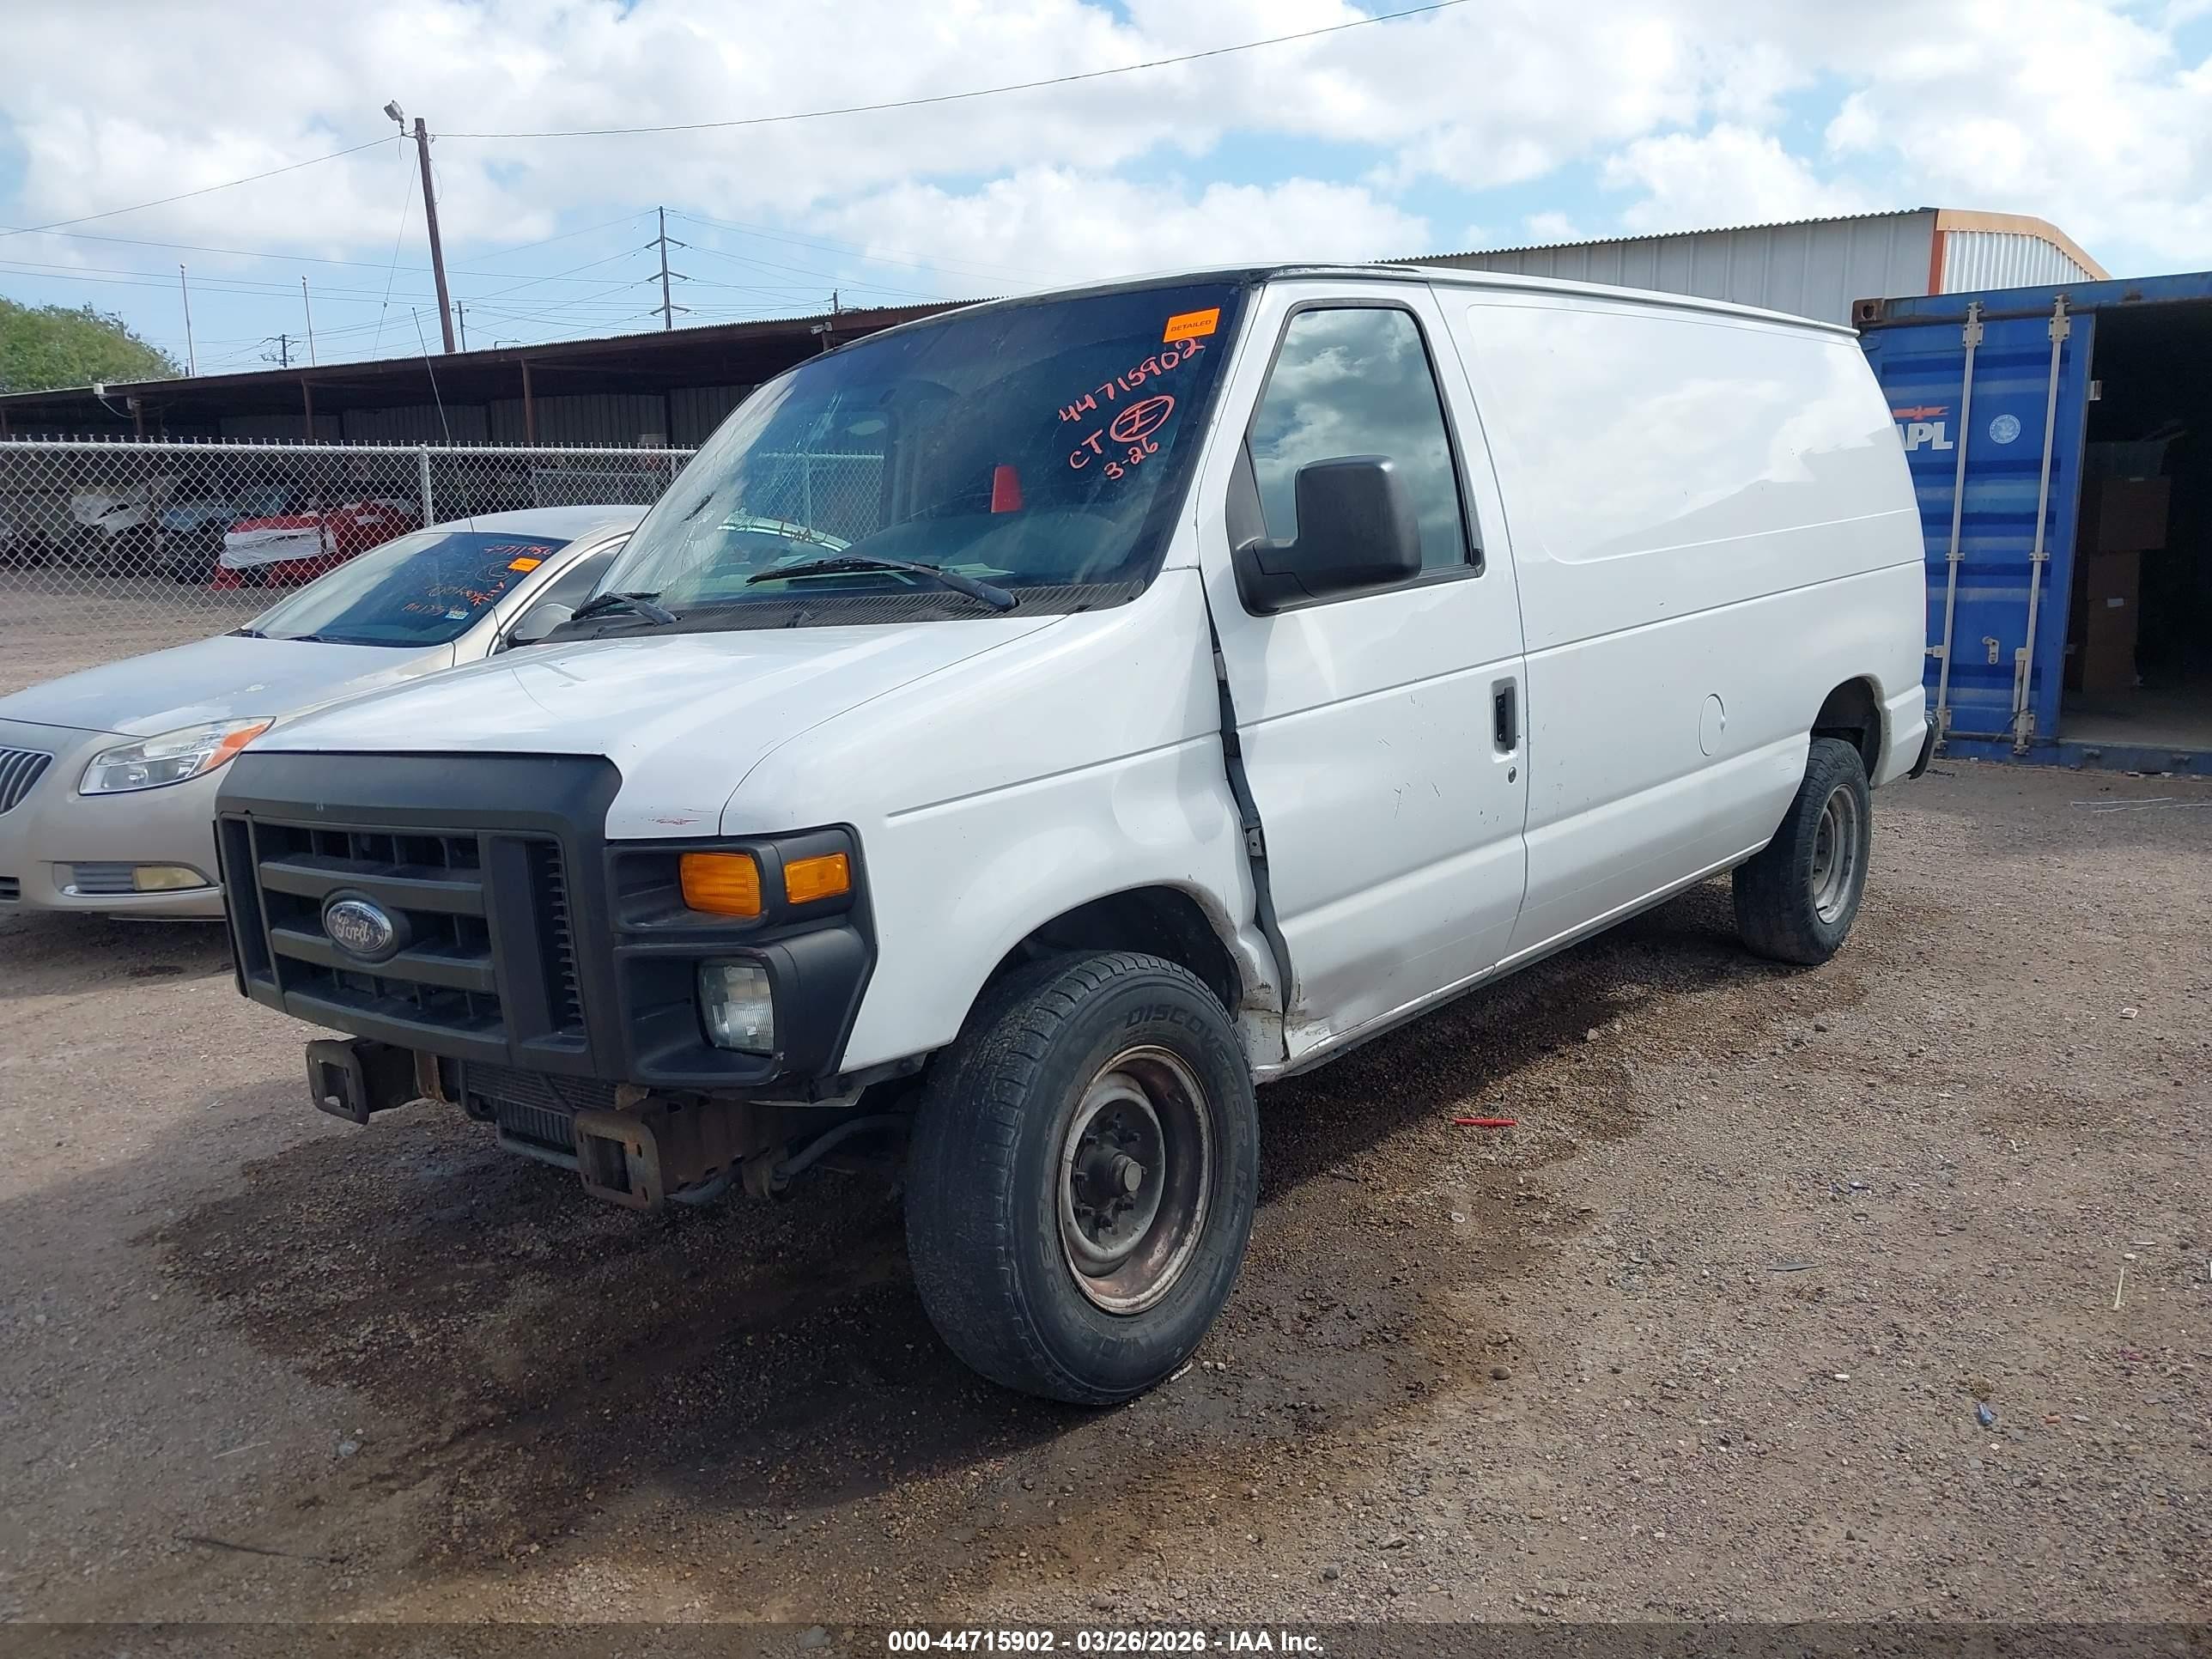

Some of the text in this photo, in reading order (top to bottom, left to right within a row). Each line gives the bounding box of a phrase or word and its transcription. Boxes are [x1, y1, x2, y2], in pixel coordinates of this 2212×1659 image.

[1170, 319, 1212, 333] DETAILED
[1058, 337, 1206, 422] 44715902
[1103, 436, 1159, 479] 3-26
[333, 909, 372, 942] Ford
